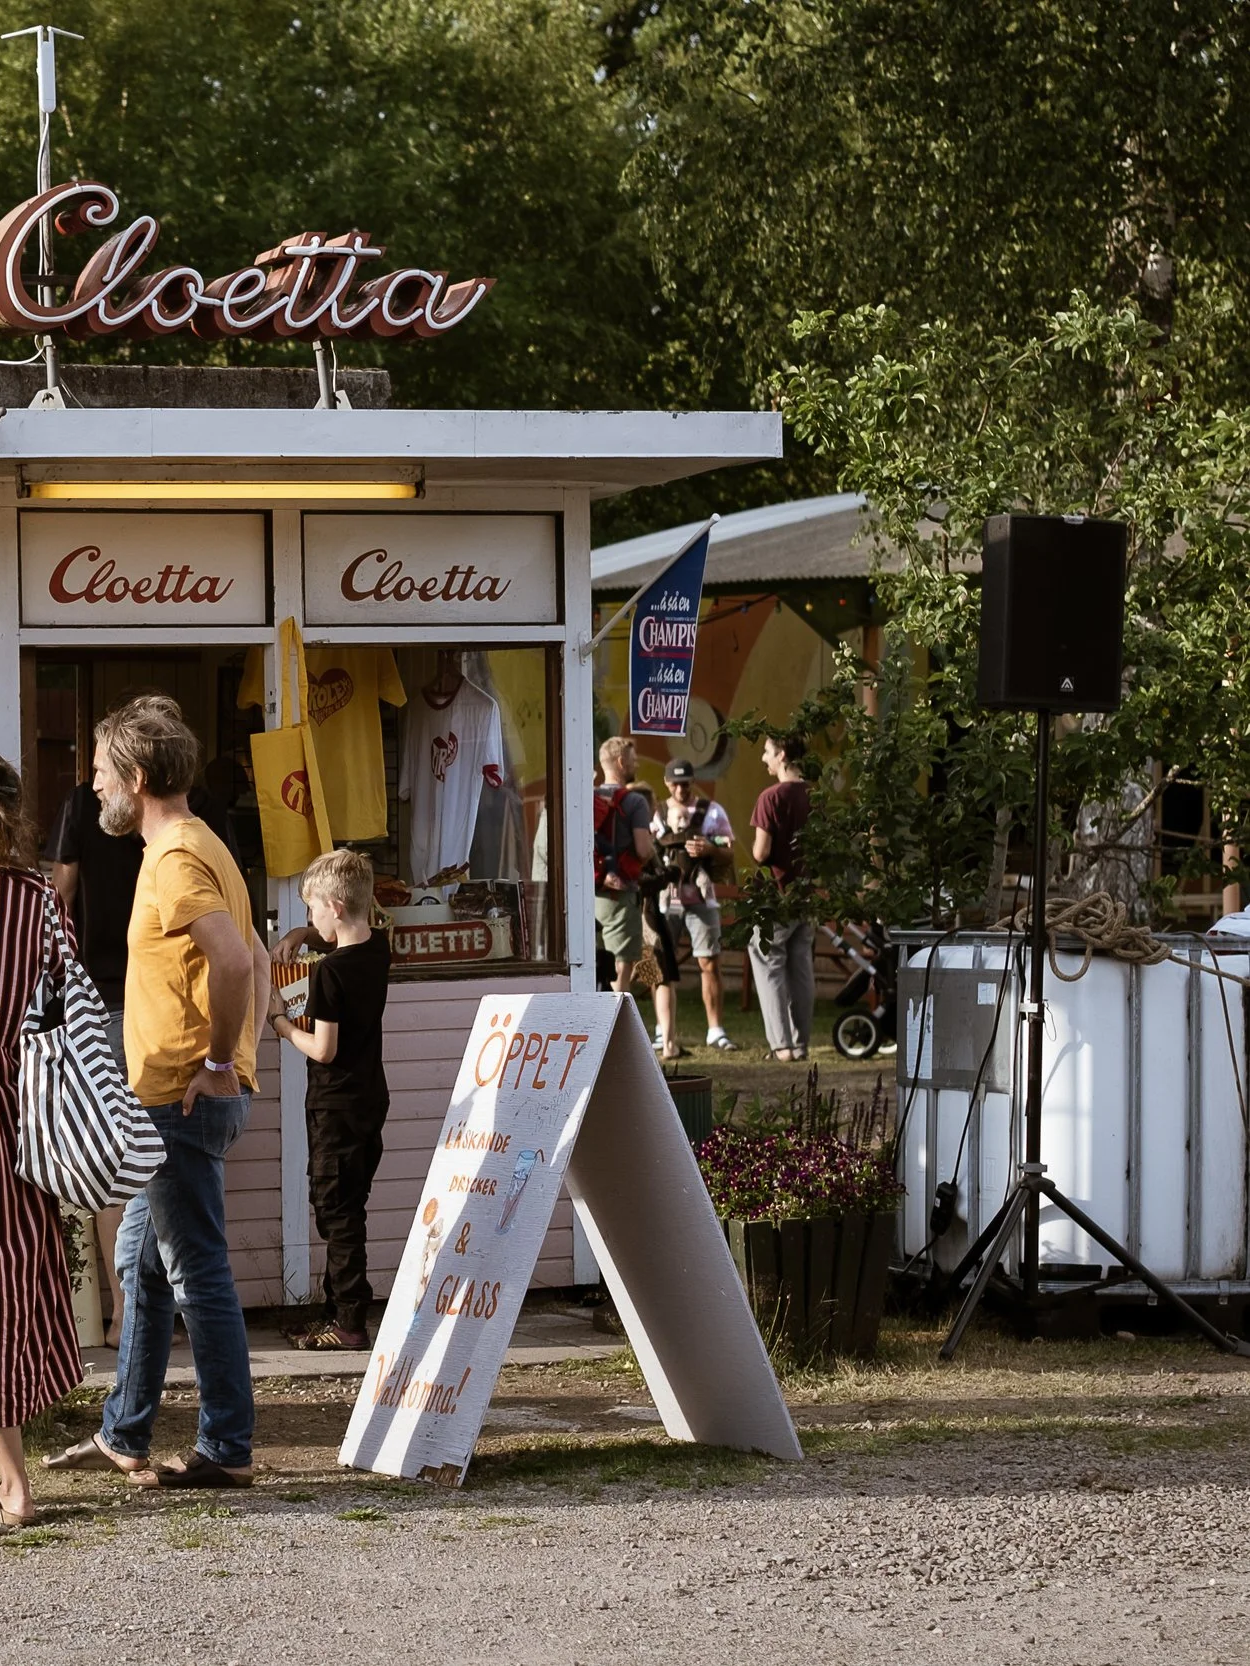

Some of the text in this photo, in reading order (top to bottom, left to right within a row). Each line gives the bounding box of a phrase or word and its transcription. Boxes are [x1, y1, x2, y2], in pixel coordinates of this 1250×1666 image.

[48, 545, 234, 603] Cloetta
[341, 549, 511, 602] Cloetta
[393, 928, 486, 955] ULETTE
[475, 1013, 589, 1090] ÖPPET
[445, 1120, 512, 1154] LÄSKANDE
[449, 1175, 497, 1197] DRYCKER
[454, 1222, 471, 1254] &
[435, 1274, 501, 1320] GLASS
[372, 1351, 471, 1415] Välkomna!
